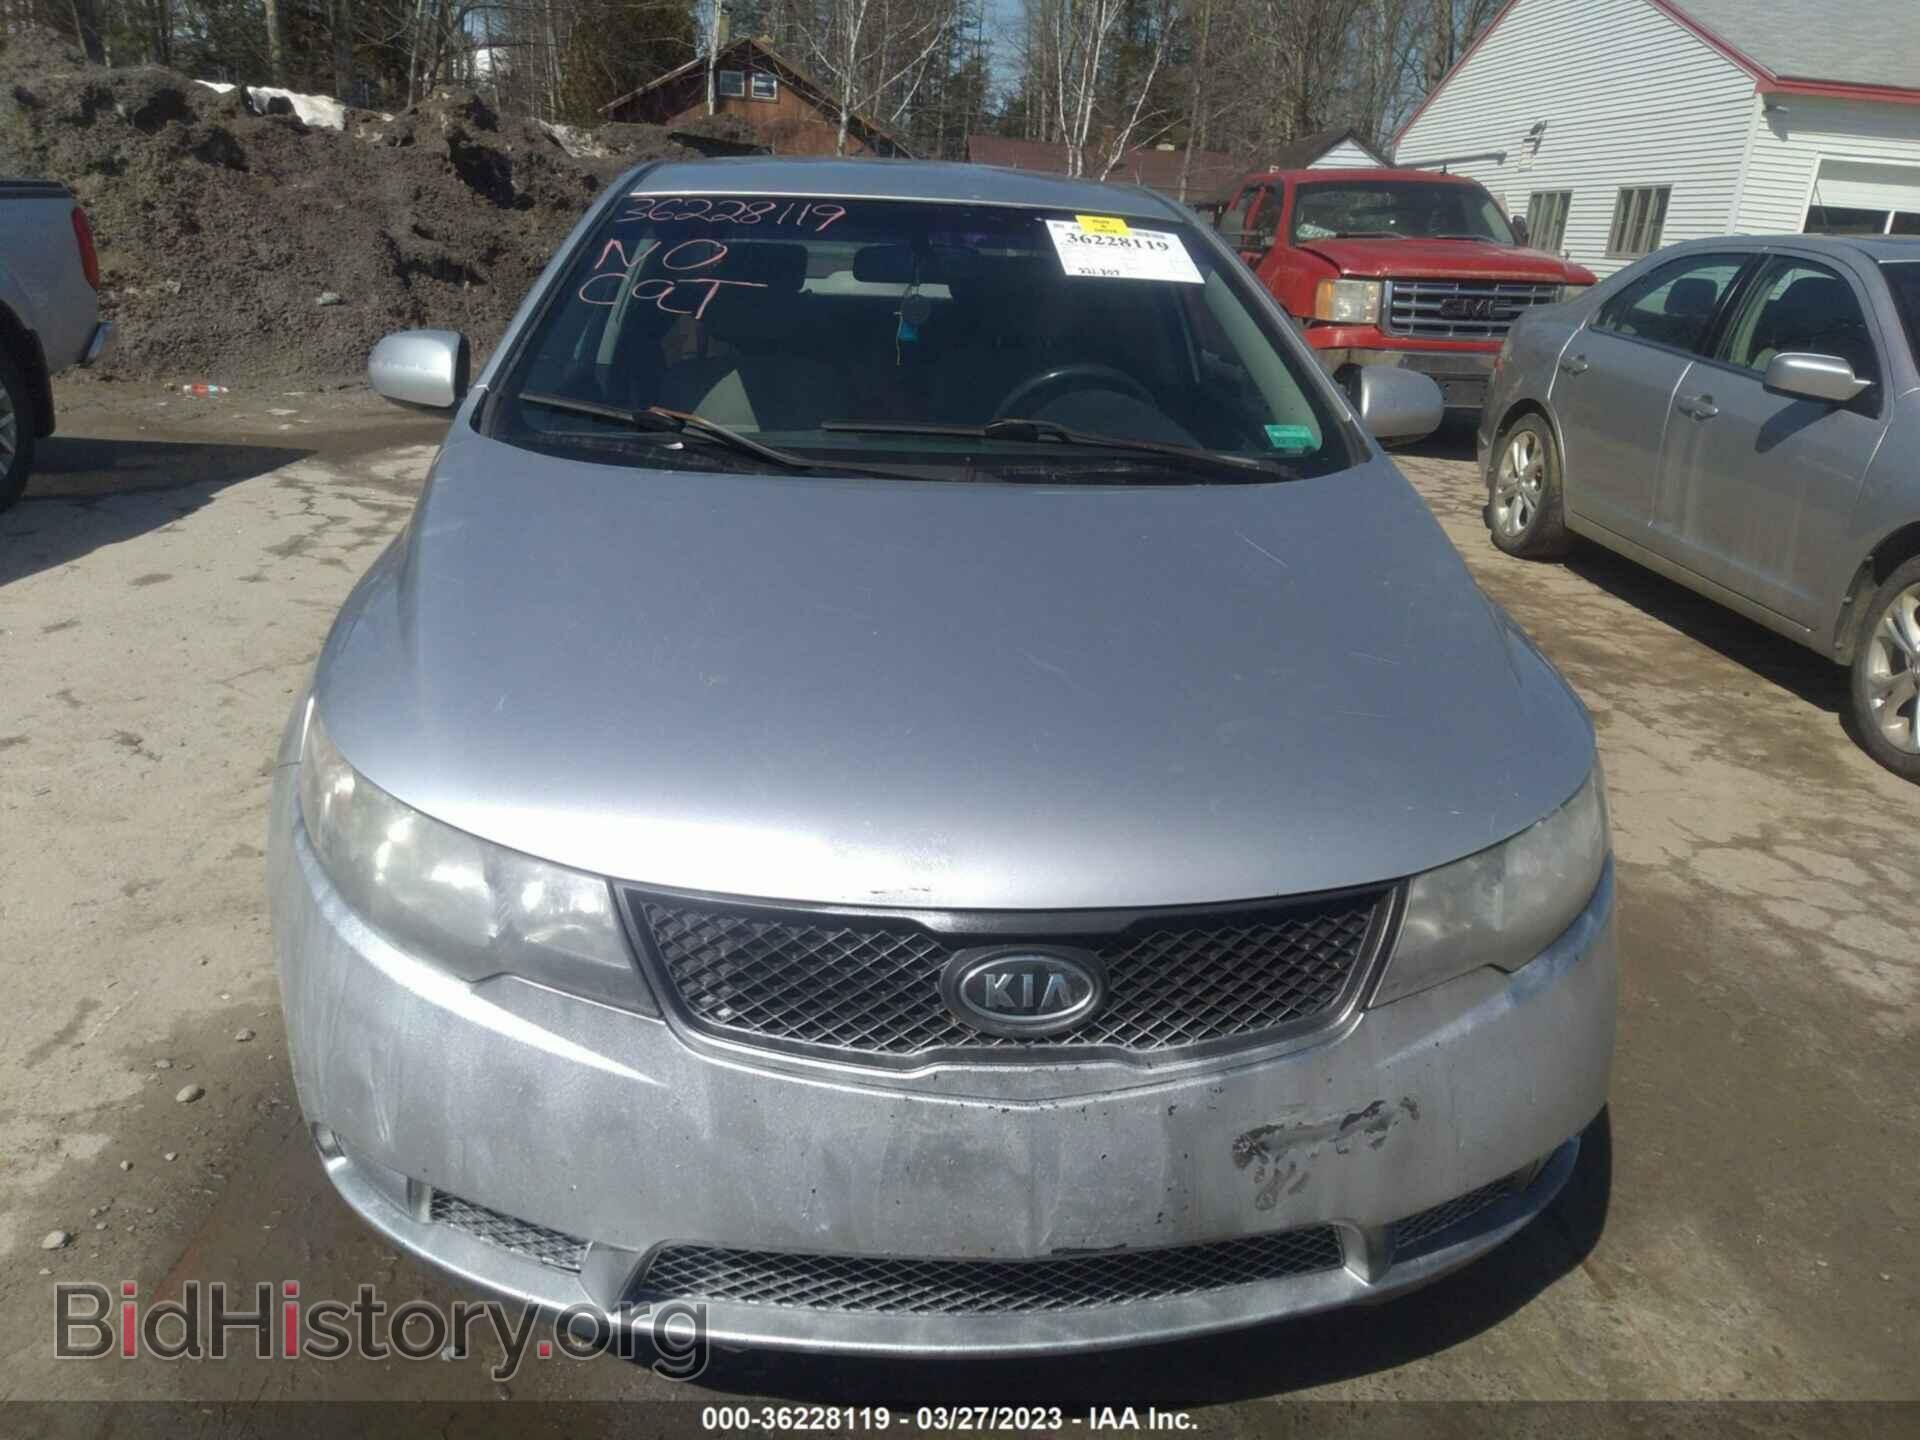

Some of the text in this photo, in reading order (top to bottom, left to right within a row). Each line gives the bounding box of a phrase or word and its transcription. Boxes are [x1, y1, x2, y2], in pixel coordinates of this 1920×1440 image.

[616, 198, 847, 231] 36228119
[594, 238, 728, 271] NO
[1065, 233, 1169, 251] 36228119
[983, 973, 1073, 1009] KIA
